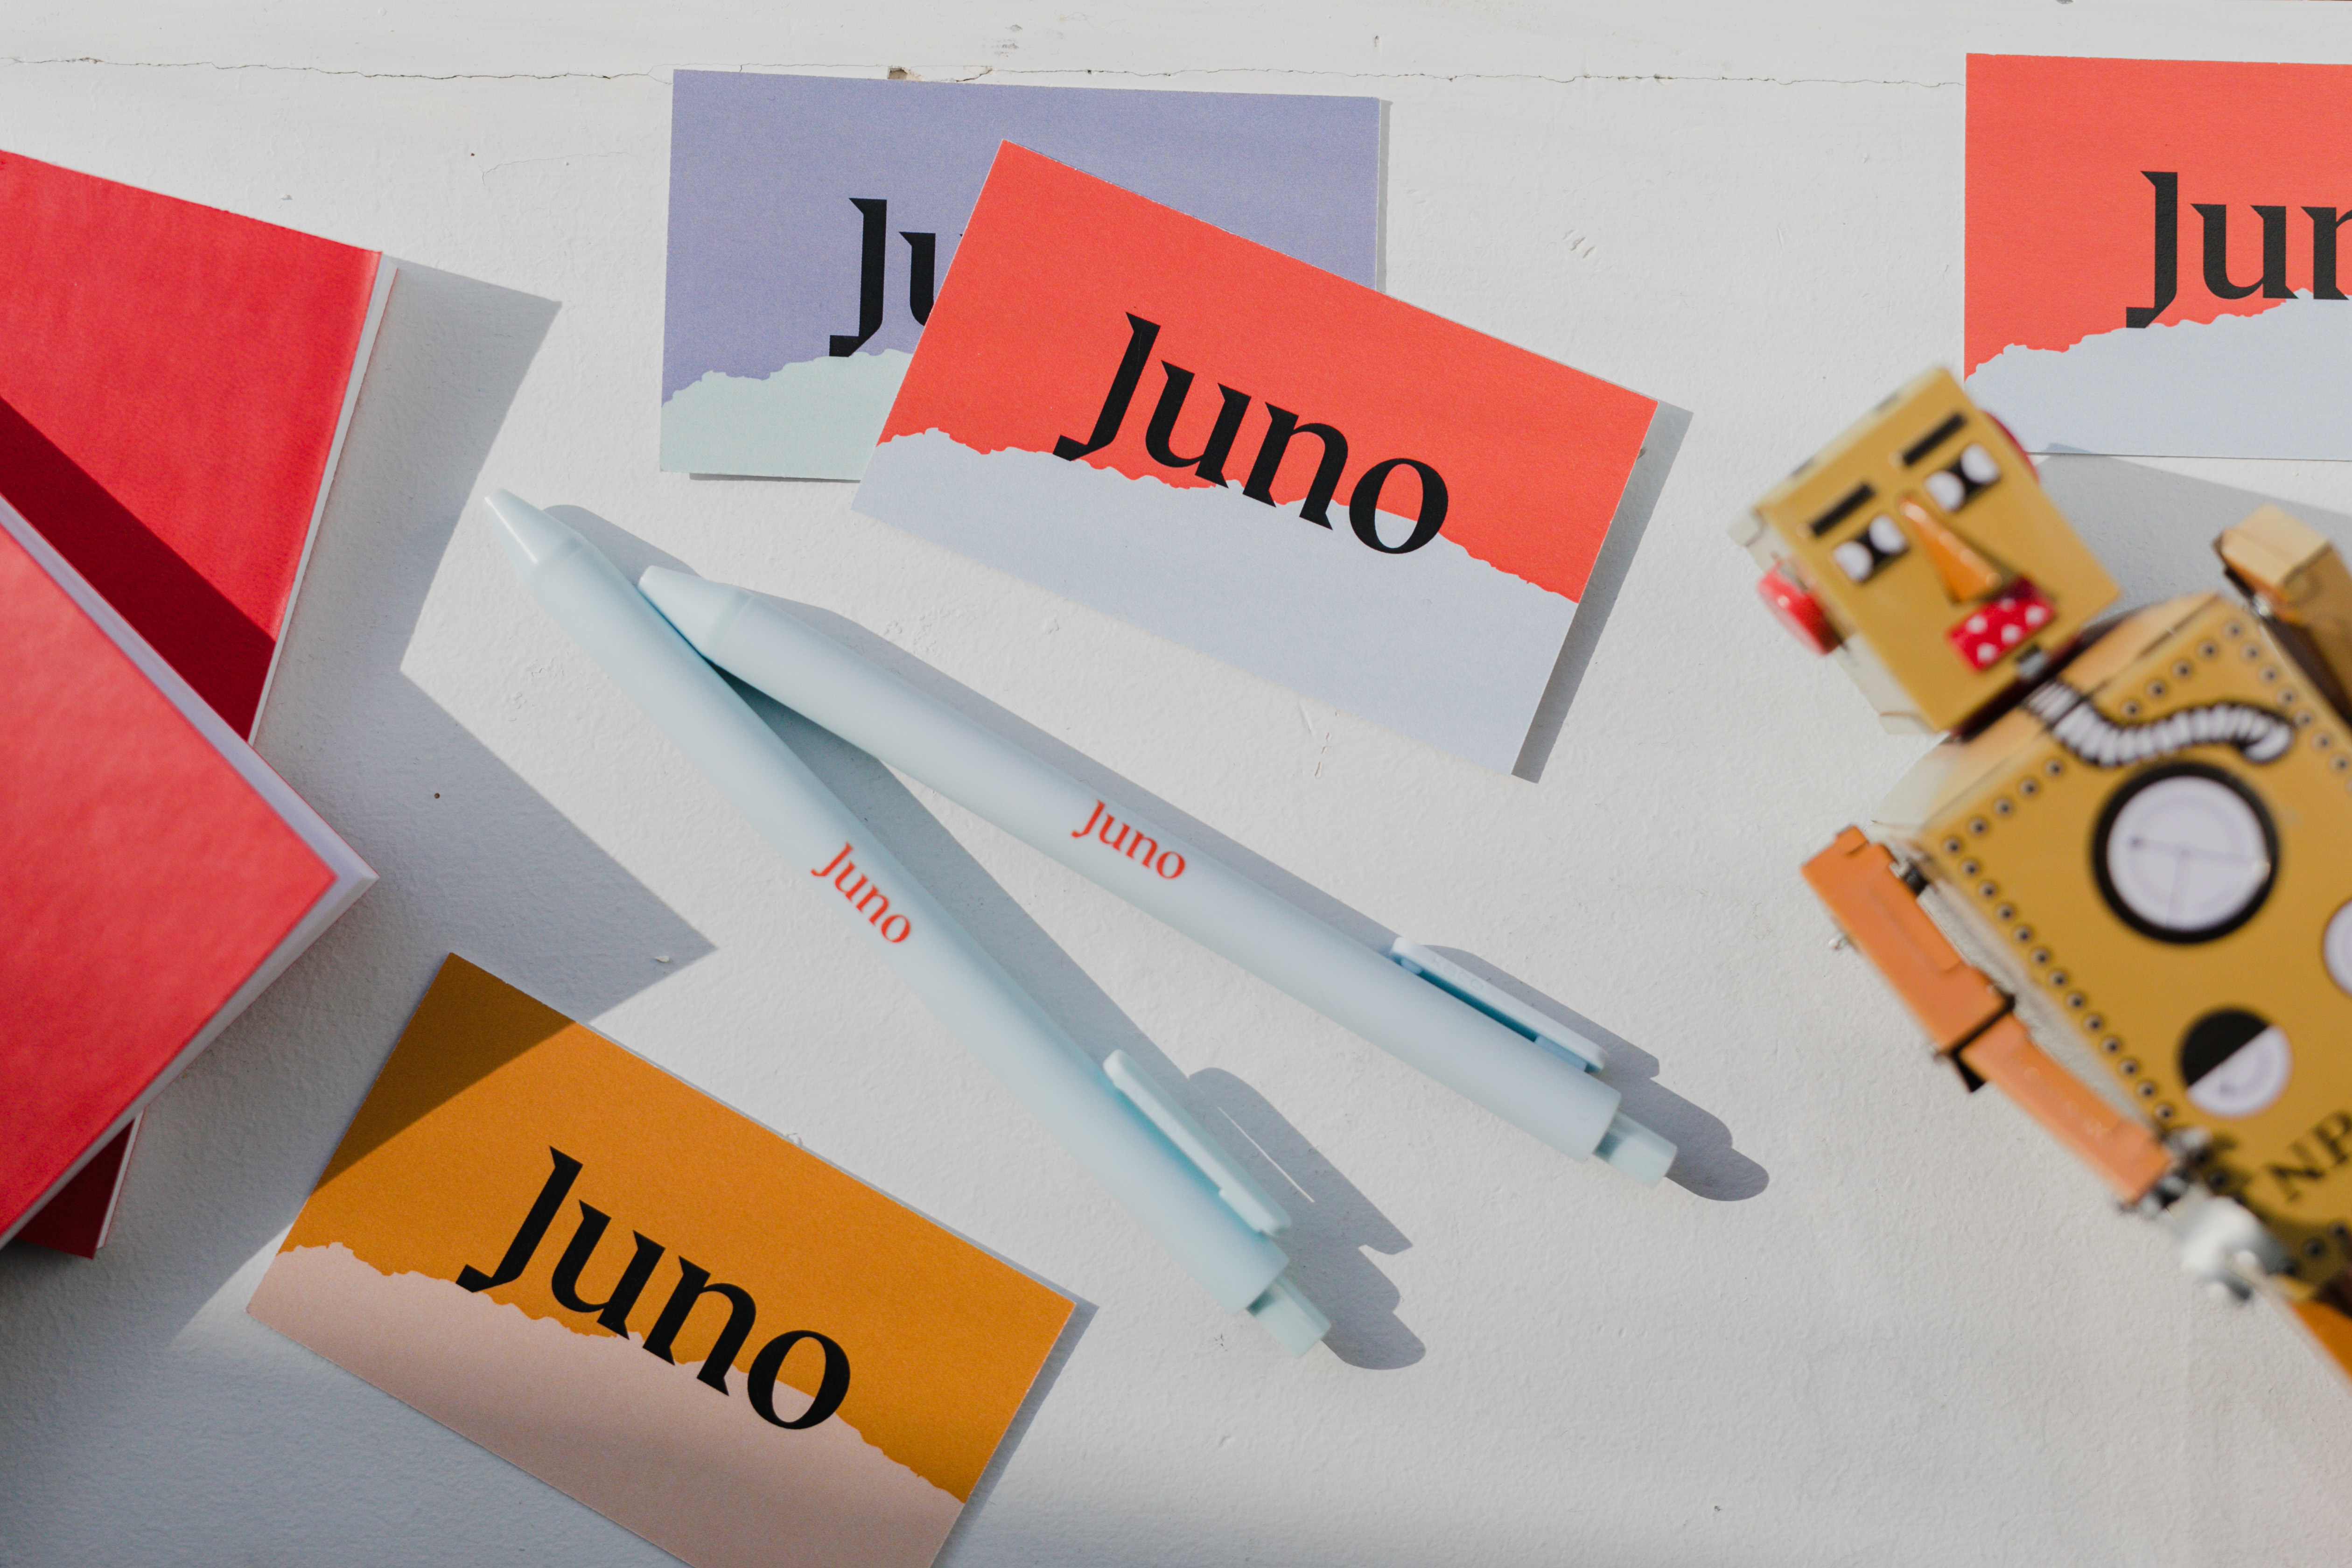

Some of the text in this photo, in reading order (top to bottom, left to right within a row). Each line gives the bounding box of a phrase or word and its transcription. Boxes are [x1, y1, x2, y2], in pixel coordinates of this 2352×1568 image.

[1052, 312, 1449, 554] Juno
[810, 842, 912, 944] Juno
[1070, 799, 1186, 880] Juno
[455, 1146, 850, 1430] Juno
